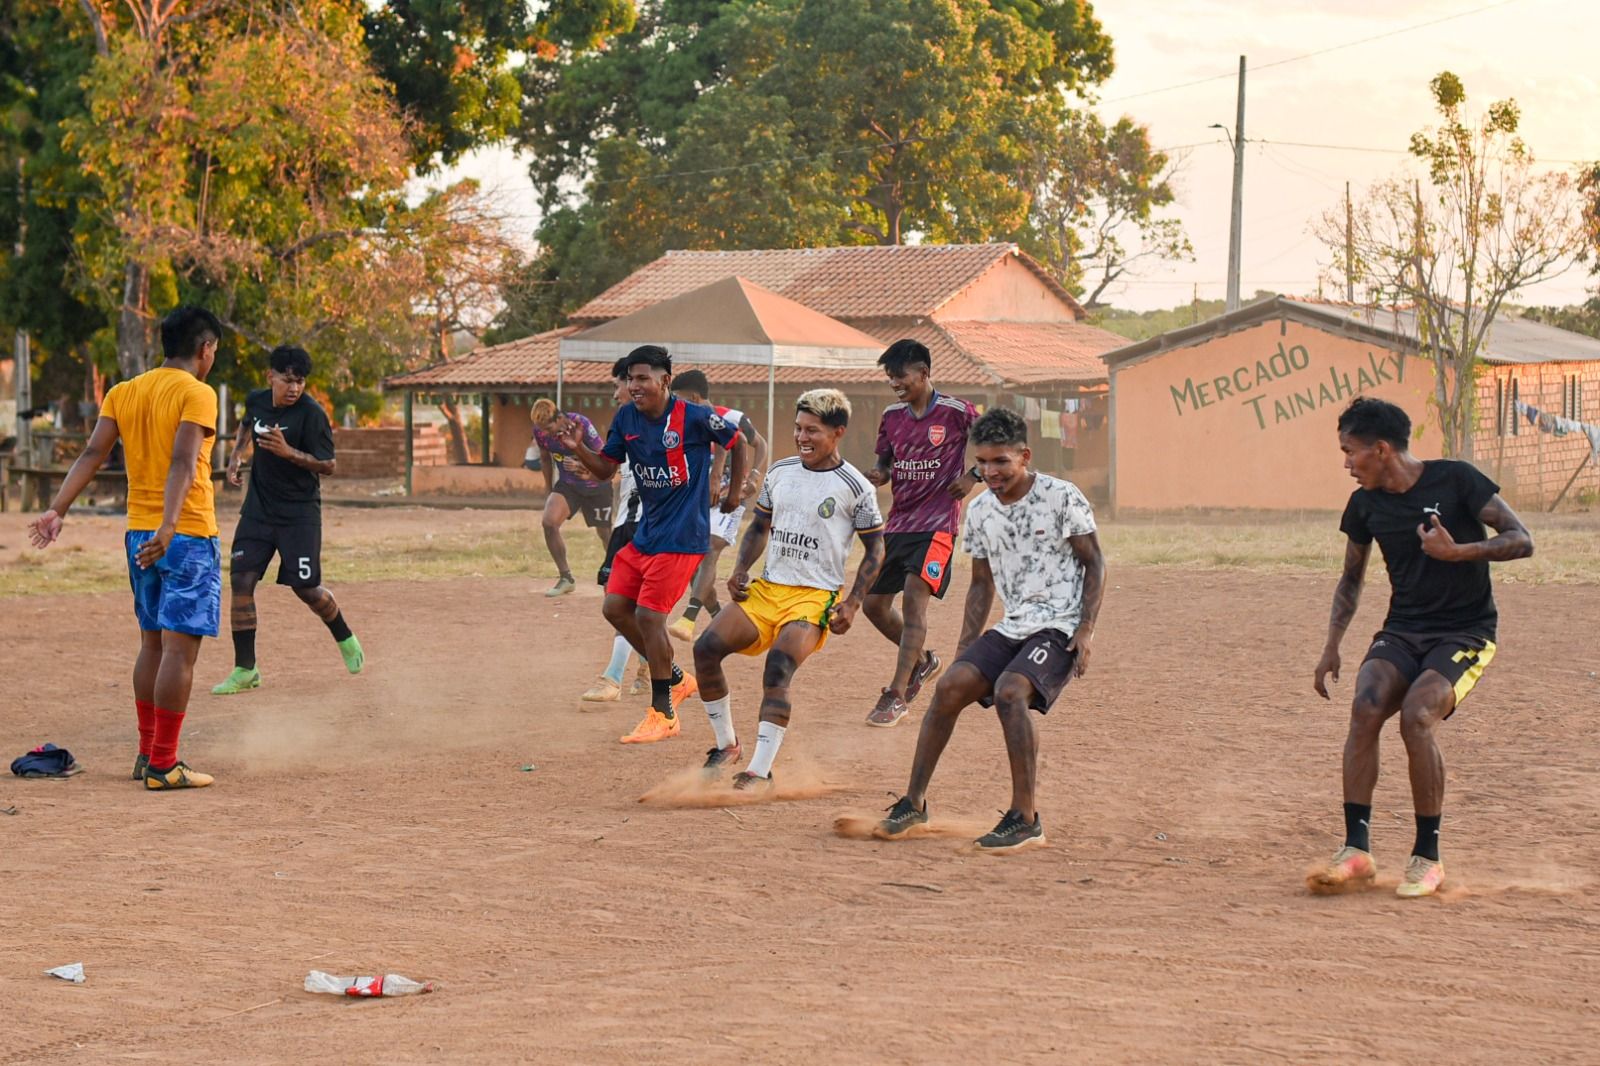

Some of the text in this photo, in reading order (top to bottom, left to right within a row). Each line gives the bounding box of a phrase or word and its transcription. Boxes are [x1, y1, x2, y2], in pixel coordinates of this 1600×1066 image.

[634, 463, 680, 480] QATAR
[907, 471, 936, 480] BETTER
[642, 477, 682, 489] AIRWAYS
[593, 506, 612, 521] 17
[781, 546, 810, 561] BETTER
[298, 557, 311, 580] 5
[1027, 647, 1049, 665] 10
